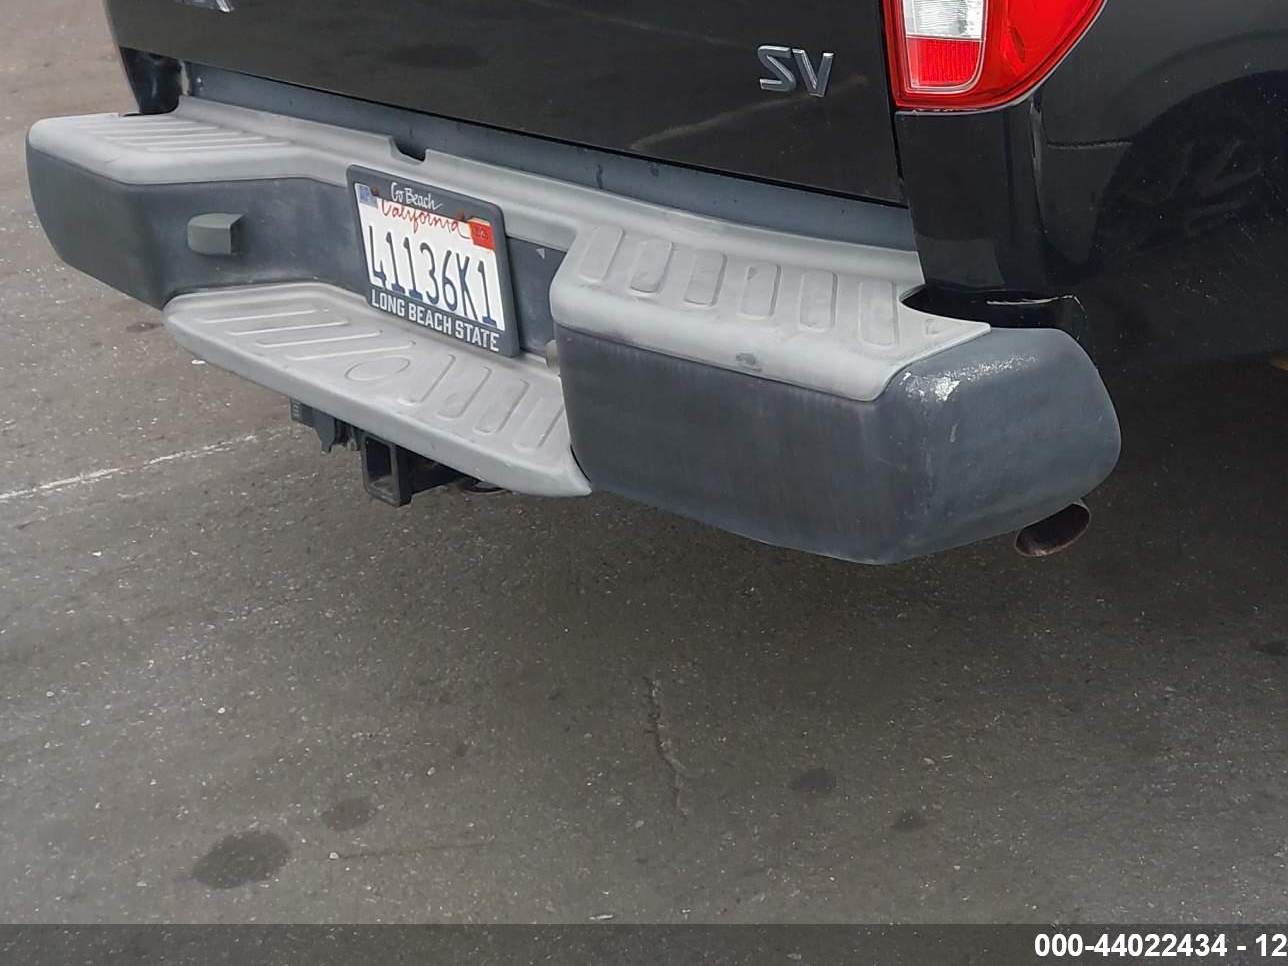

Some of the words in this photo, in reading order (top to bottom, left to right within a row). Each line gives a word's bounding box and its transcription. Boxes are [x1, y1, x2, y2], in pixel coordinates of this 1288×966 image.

[757, 44, 835, 98] SV
[381, 198, 461, 235] California
[404, 187, 443, 210] Beach
[369, 225, 498, 326] 41136K1
[371, 289, 406, 317] LONG
[408, 302, 452, 335] BEACH
[454, 320, 500, 352] STATE
